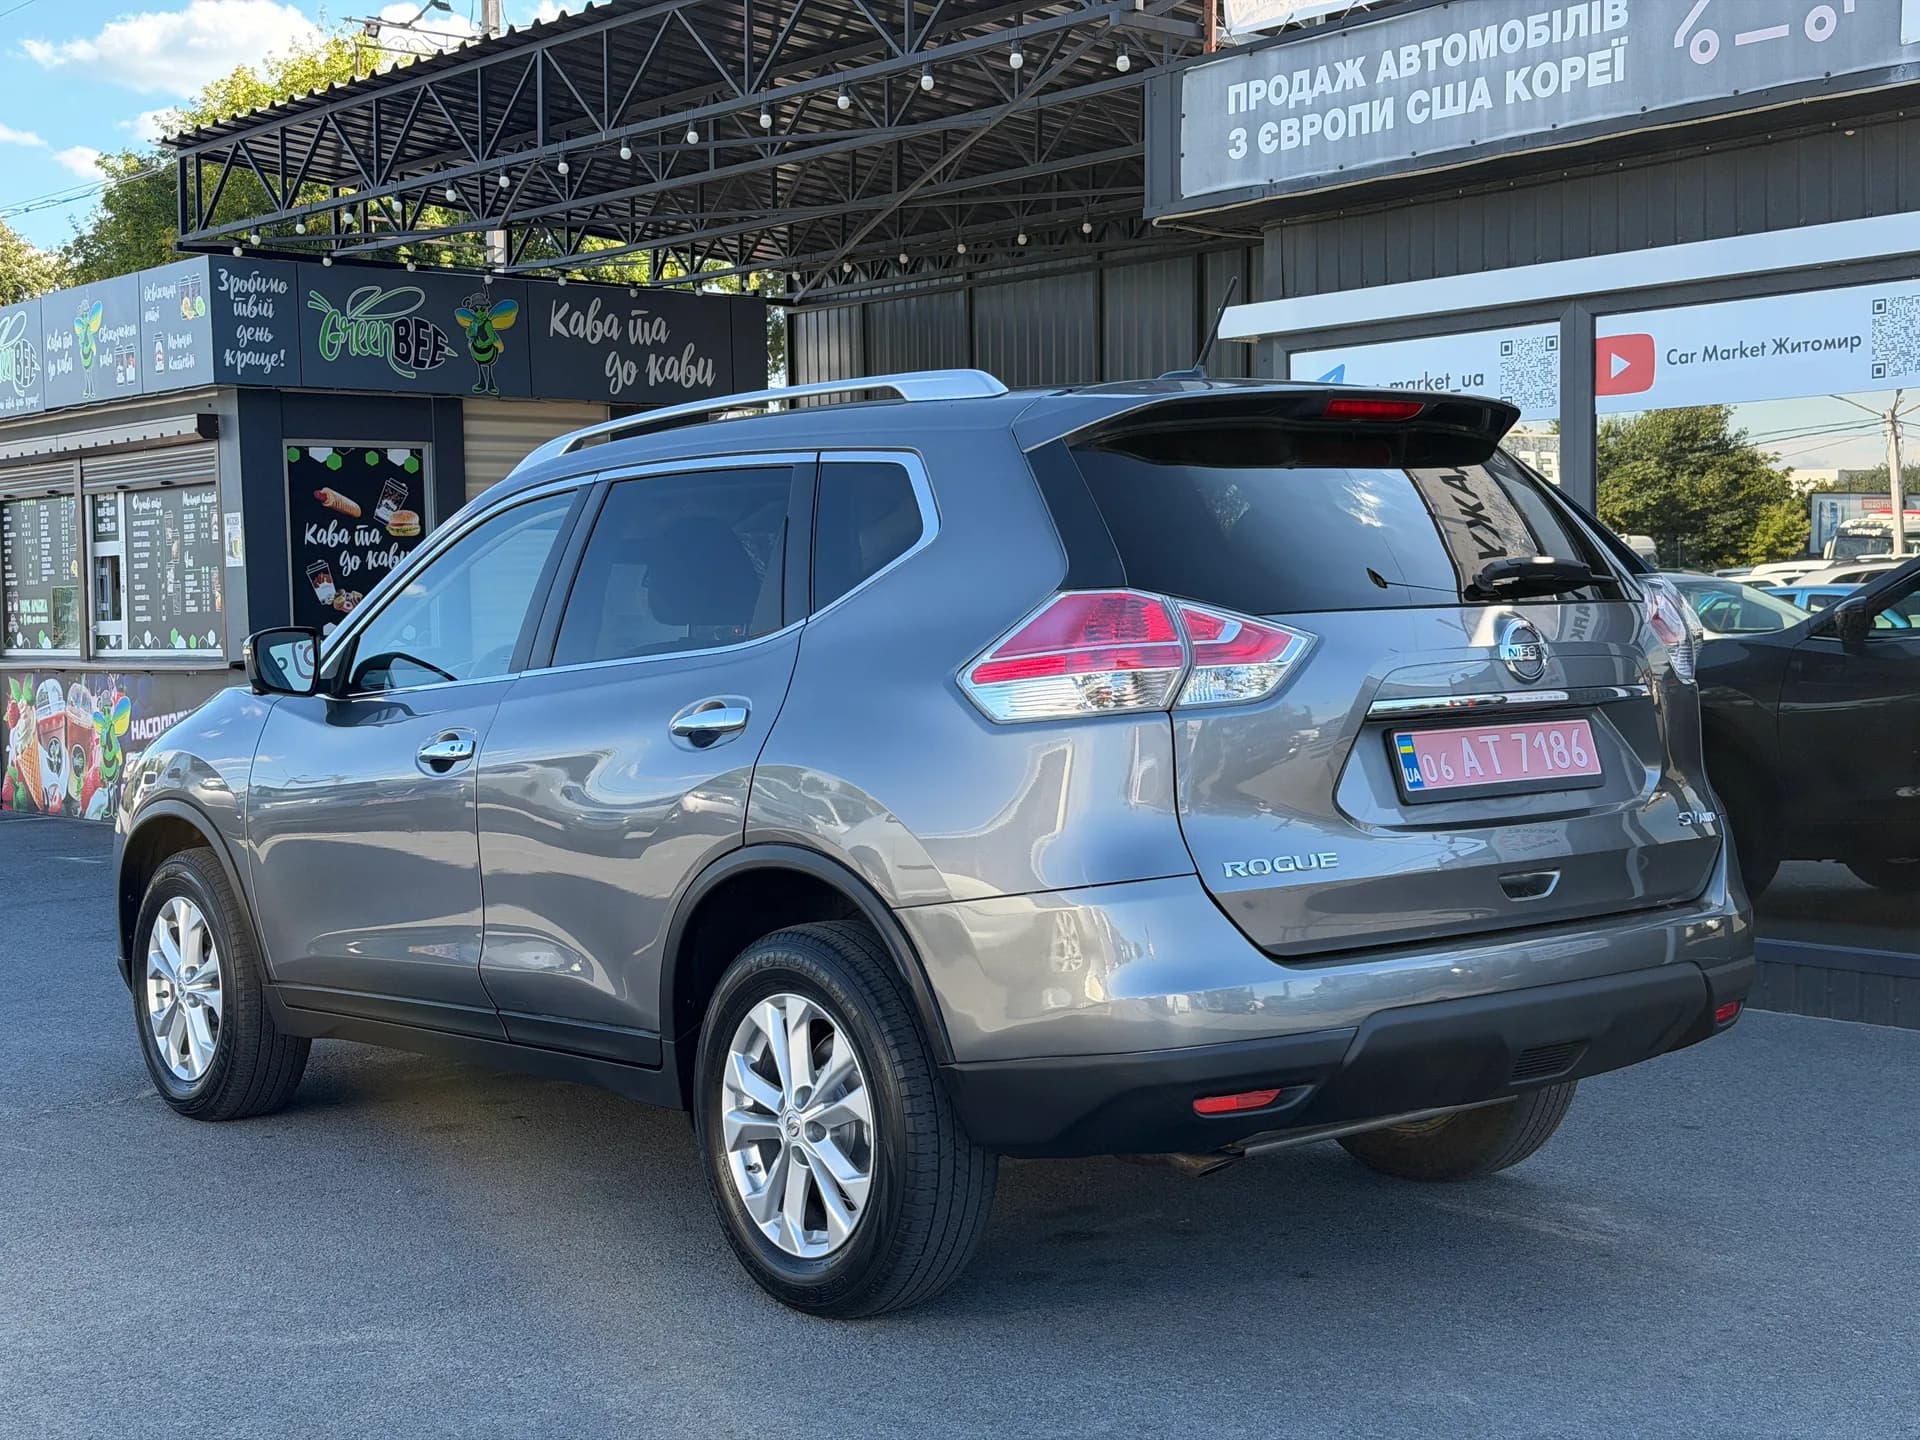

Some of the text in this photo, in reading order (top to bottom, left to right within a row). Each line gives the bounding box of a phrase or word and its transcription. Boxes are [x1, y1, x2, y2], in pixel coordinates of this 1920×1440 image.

[1228, 0, 1629, 115] ПРОДАЖ АВТОМОБІЛІВ
[1228, 36, 1628, 160] З ЄВРОПИ США КОРЕЇ
[217, 268, 288, 300] Зробимо
[232, 294, 275, 319] твій
[236, 324, 274, 347] день
[550, 297, 670, 346] Кава та
[223, 348, 286, 375] краще!
[1666, 333, 1862, 366] Car Market Житомир
[605, 342, 716, 394] до кави
[1376, 371, 1484, 393] market_ua
[304, 519, 383, 548] Кава та
[339, 550, 361, 577] до
[1421, 728, 1588, 783] 06 AT 7186
[1404, 766, 1422, 783] UA
[1222, 852, 1340, 879] ROGUE
